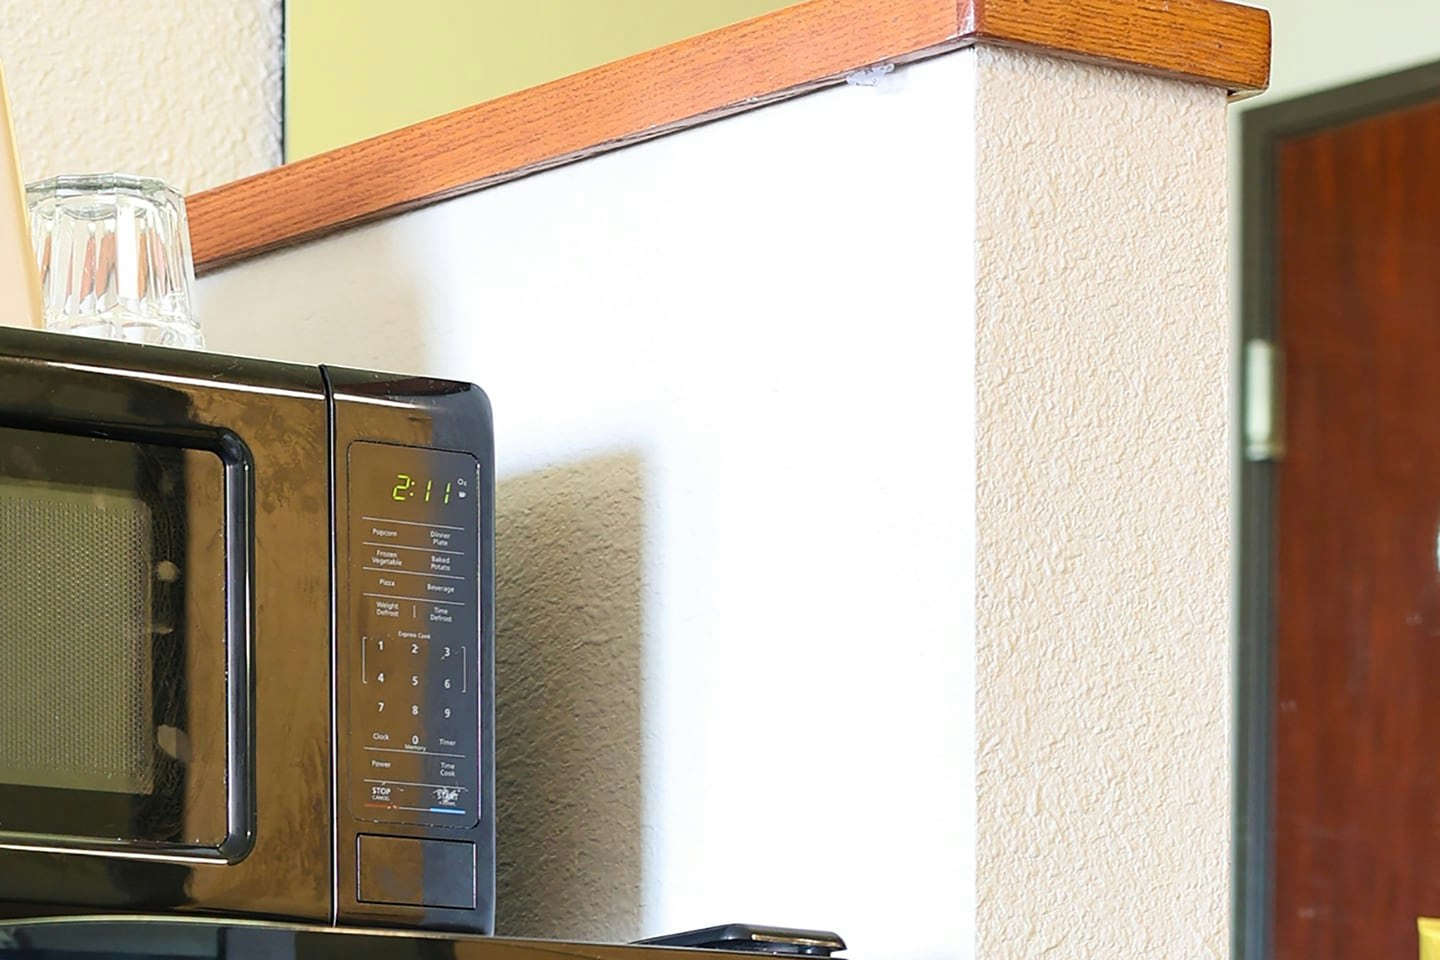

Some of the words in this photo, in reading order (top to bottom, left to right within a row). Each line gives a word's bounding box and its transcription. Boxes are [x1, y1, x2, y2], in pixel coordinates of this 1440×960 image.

[392, 473, 452, 504] 2:11
[372, 528, 398, 538] Popcorn
[430, 530, 451, 540] Dinner
[432, 538, 449, 546] Plate
[376, 550, 398, 559] Frozen
[372, 557, 403, 566] Vegetable
[431, 555, 451, 564] Baked
[430, 563, 451, 572] Potato
[379, 578, 396, 587] Pizza
[427, 583, 455, 593] Beverage
[376, 601, 399, 611] Weight
[434, 606, 448, 615] Time
[376, 608, 399, 617] Defrost
[430, 614, 452, 623] Defrost
[398, 630, 417, 639] Express
[418, 632, 431, 640] Cook
[377, 640, 384, 650] 1
[411, 643, 419, 654] 2
[444, 647, 451, 657] 3
[377, 672, 385, 683] 4
[412, 676, 419, 686] 5
[444, 679, 451, 689] 6
[377, 702, 385, 712] 7
[412, 705, 419, 715] 8
[444, 708, 451, 718] 9
[372, 732, 389, 741] Clock
[412, 735, 419, 745] 0
[439, 738, 456, 747] Timer
[404, 744, 426, 753] Memory
[372, 760, 391, 769] Power
[440, 762, 455, 770] Time
[440, 769, 456, 777] Cook
[372, 786, 391, 795] STOP
